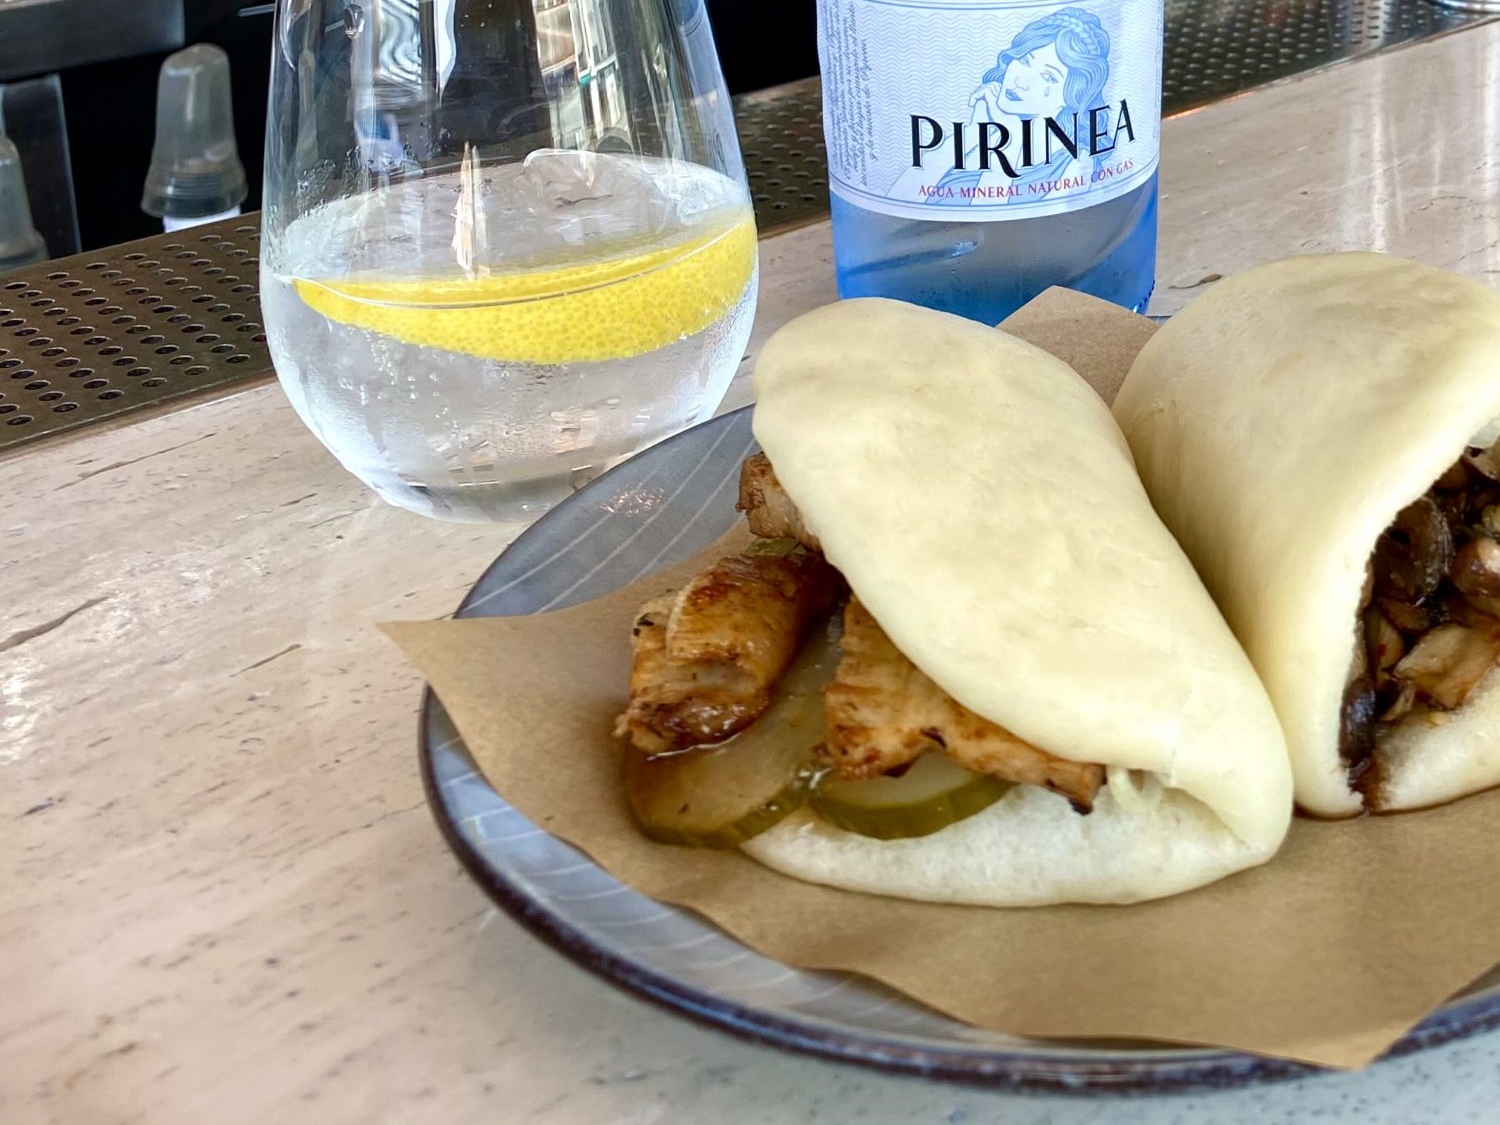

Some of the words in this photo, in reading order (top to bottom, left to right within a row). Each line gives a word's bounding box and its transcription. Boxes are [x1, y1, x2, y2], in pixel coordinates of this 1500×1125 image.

[909, 99, 1137, 178] PIRINEA
[918, 184, 955, 198] AGUA
[959, 182, 1023, 198] MINERAL
[1028, 176, 1086, 196] NATURAL
[1090, 168, 1114, 184] CON
[1115, 157, 1135, 176] GAS
